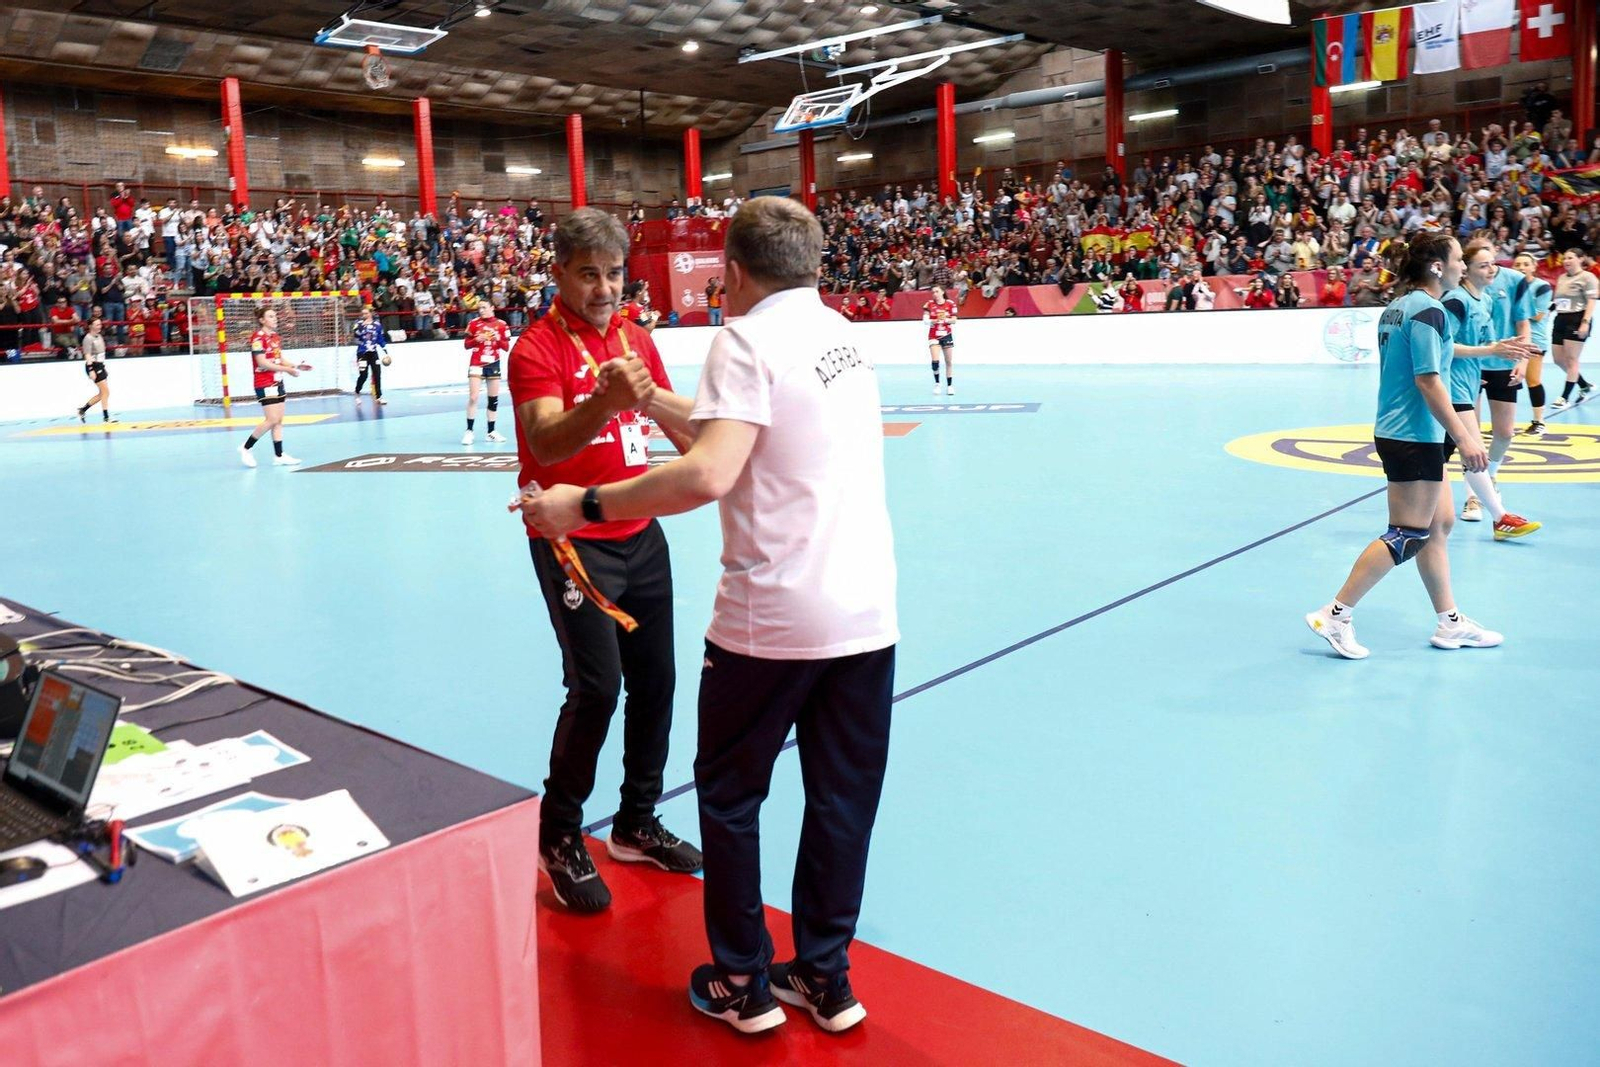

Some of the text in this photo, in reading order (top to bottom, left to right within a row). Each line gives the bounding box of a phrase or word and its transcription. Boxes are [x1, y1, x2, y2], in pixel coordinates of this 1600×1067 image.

[1416, 23, 1443, 40] EHF
[815, 346, 874, 389] AZERBA
[630, 442, 638, 454] A
